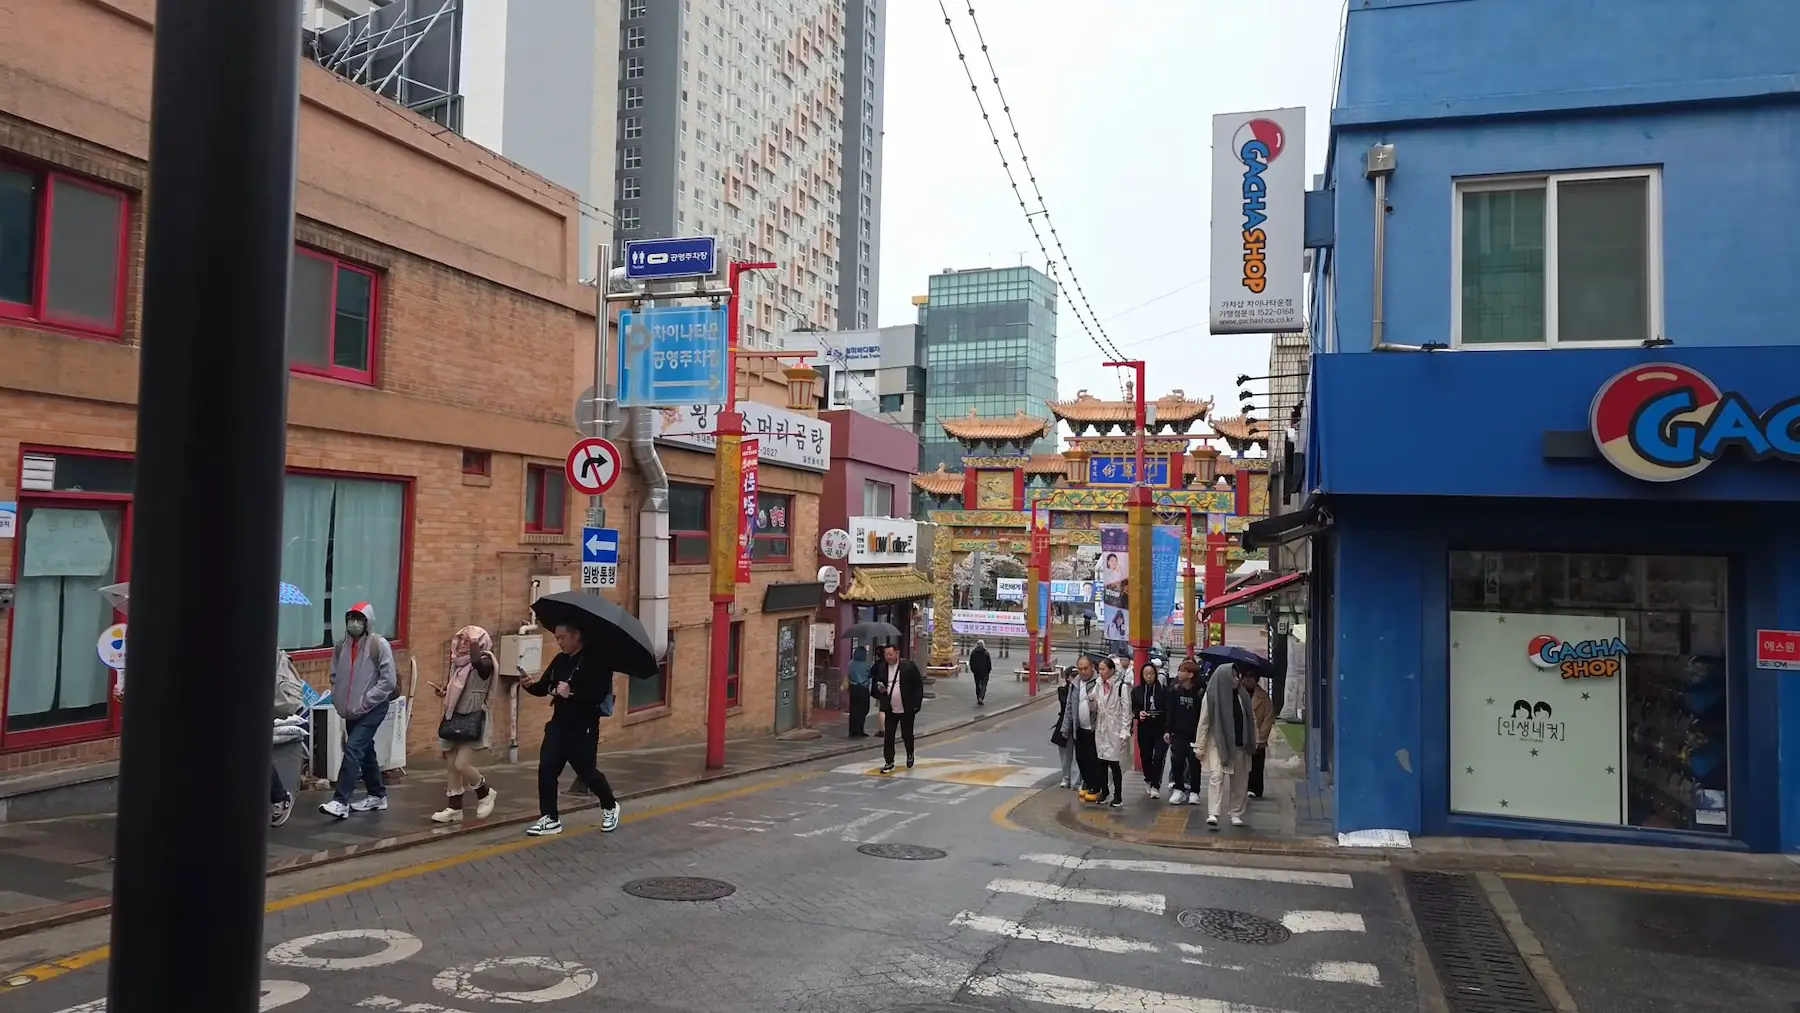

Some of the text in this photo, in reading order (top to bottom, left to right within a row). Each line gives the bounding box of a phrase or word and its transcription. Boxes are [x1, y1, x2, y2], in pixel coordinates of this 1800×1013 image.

[1241, 139, 1270, 230] GACHA
[670, 251, 708, 262] 공영주차장
[1242, 228, 1267, 293] SHOP
[1246, 298, 1292, 307] 차이나타운점
[1219, 308, 1295, 318] 가맹점문의 1522-0168
[1219, 316, 1294, 325] www.gachashop.co.kr
[653, 322, 718, 342] 차이나타운
[653, 349, 720, 369] 공영주차장
[583, 565, 616, 585] 일방통행
[1540, 636, 1630, 664] GACHA
[1764, 640, 1795, 653] 에스원
[1560, 659, 1620, 679] SHOP
